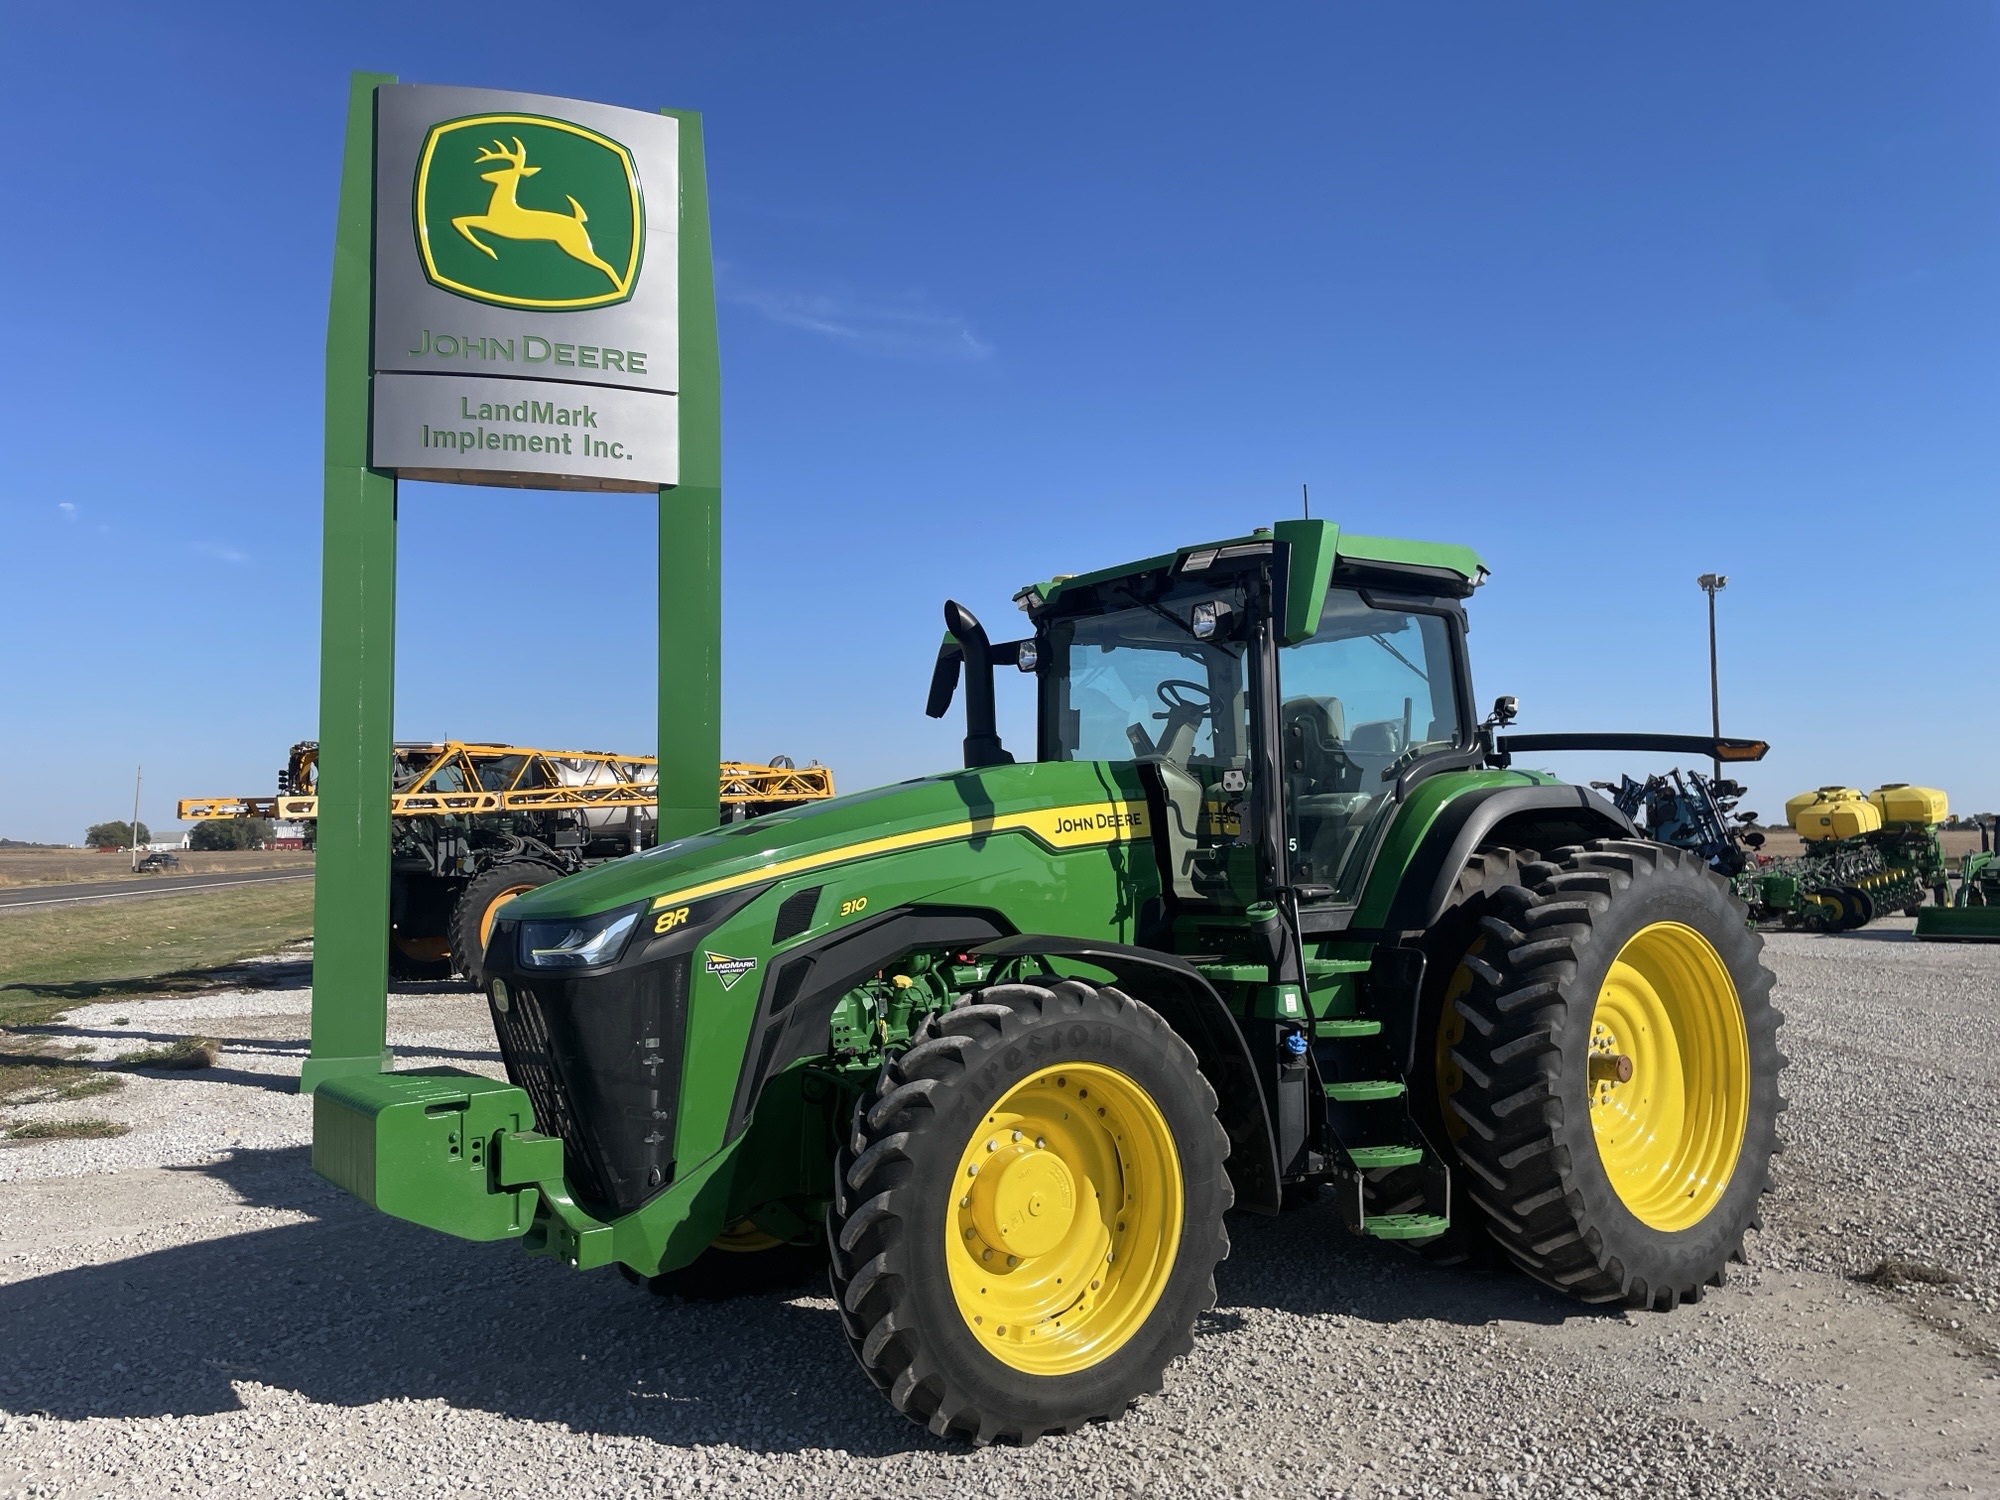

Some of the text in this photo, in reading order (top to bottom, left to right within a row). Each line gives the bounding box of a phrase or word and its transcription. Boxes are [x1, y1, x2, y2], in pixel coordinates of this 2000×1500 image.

[409, 329, 648, 375] JOHN DEERE
[461, 397, 598, 428] LandMark
[421, 424, 633, 461] Implement Inc.
[1055, 812, 1142, 833] JOHN DEERE
[654, 907, 690, 934] 8R
[840, 897, 868, 917] 310
[708, 961, 755, 970] LANDMARK
